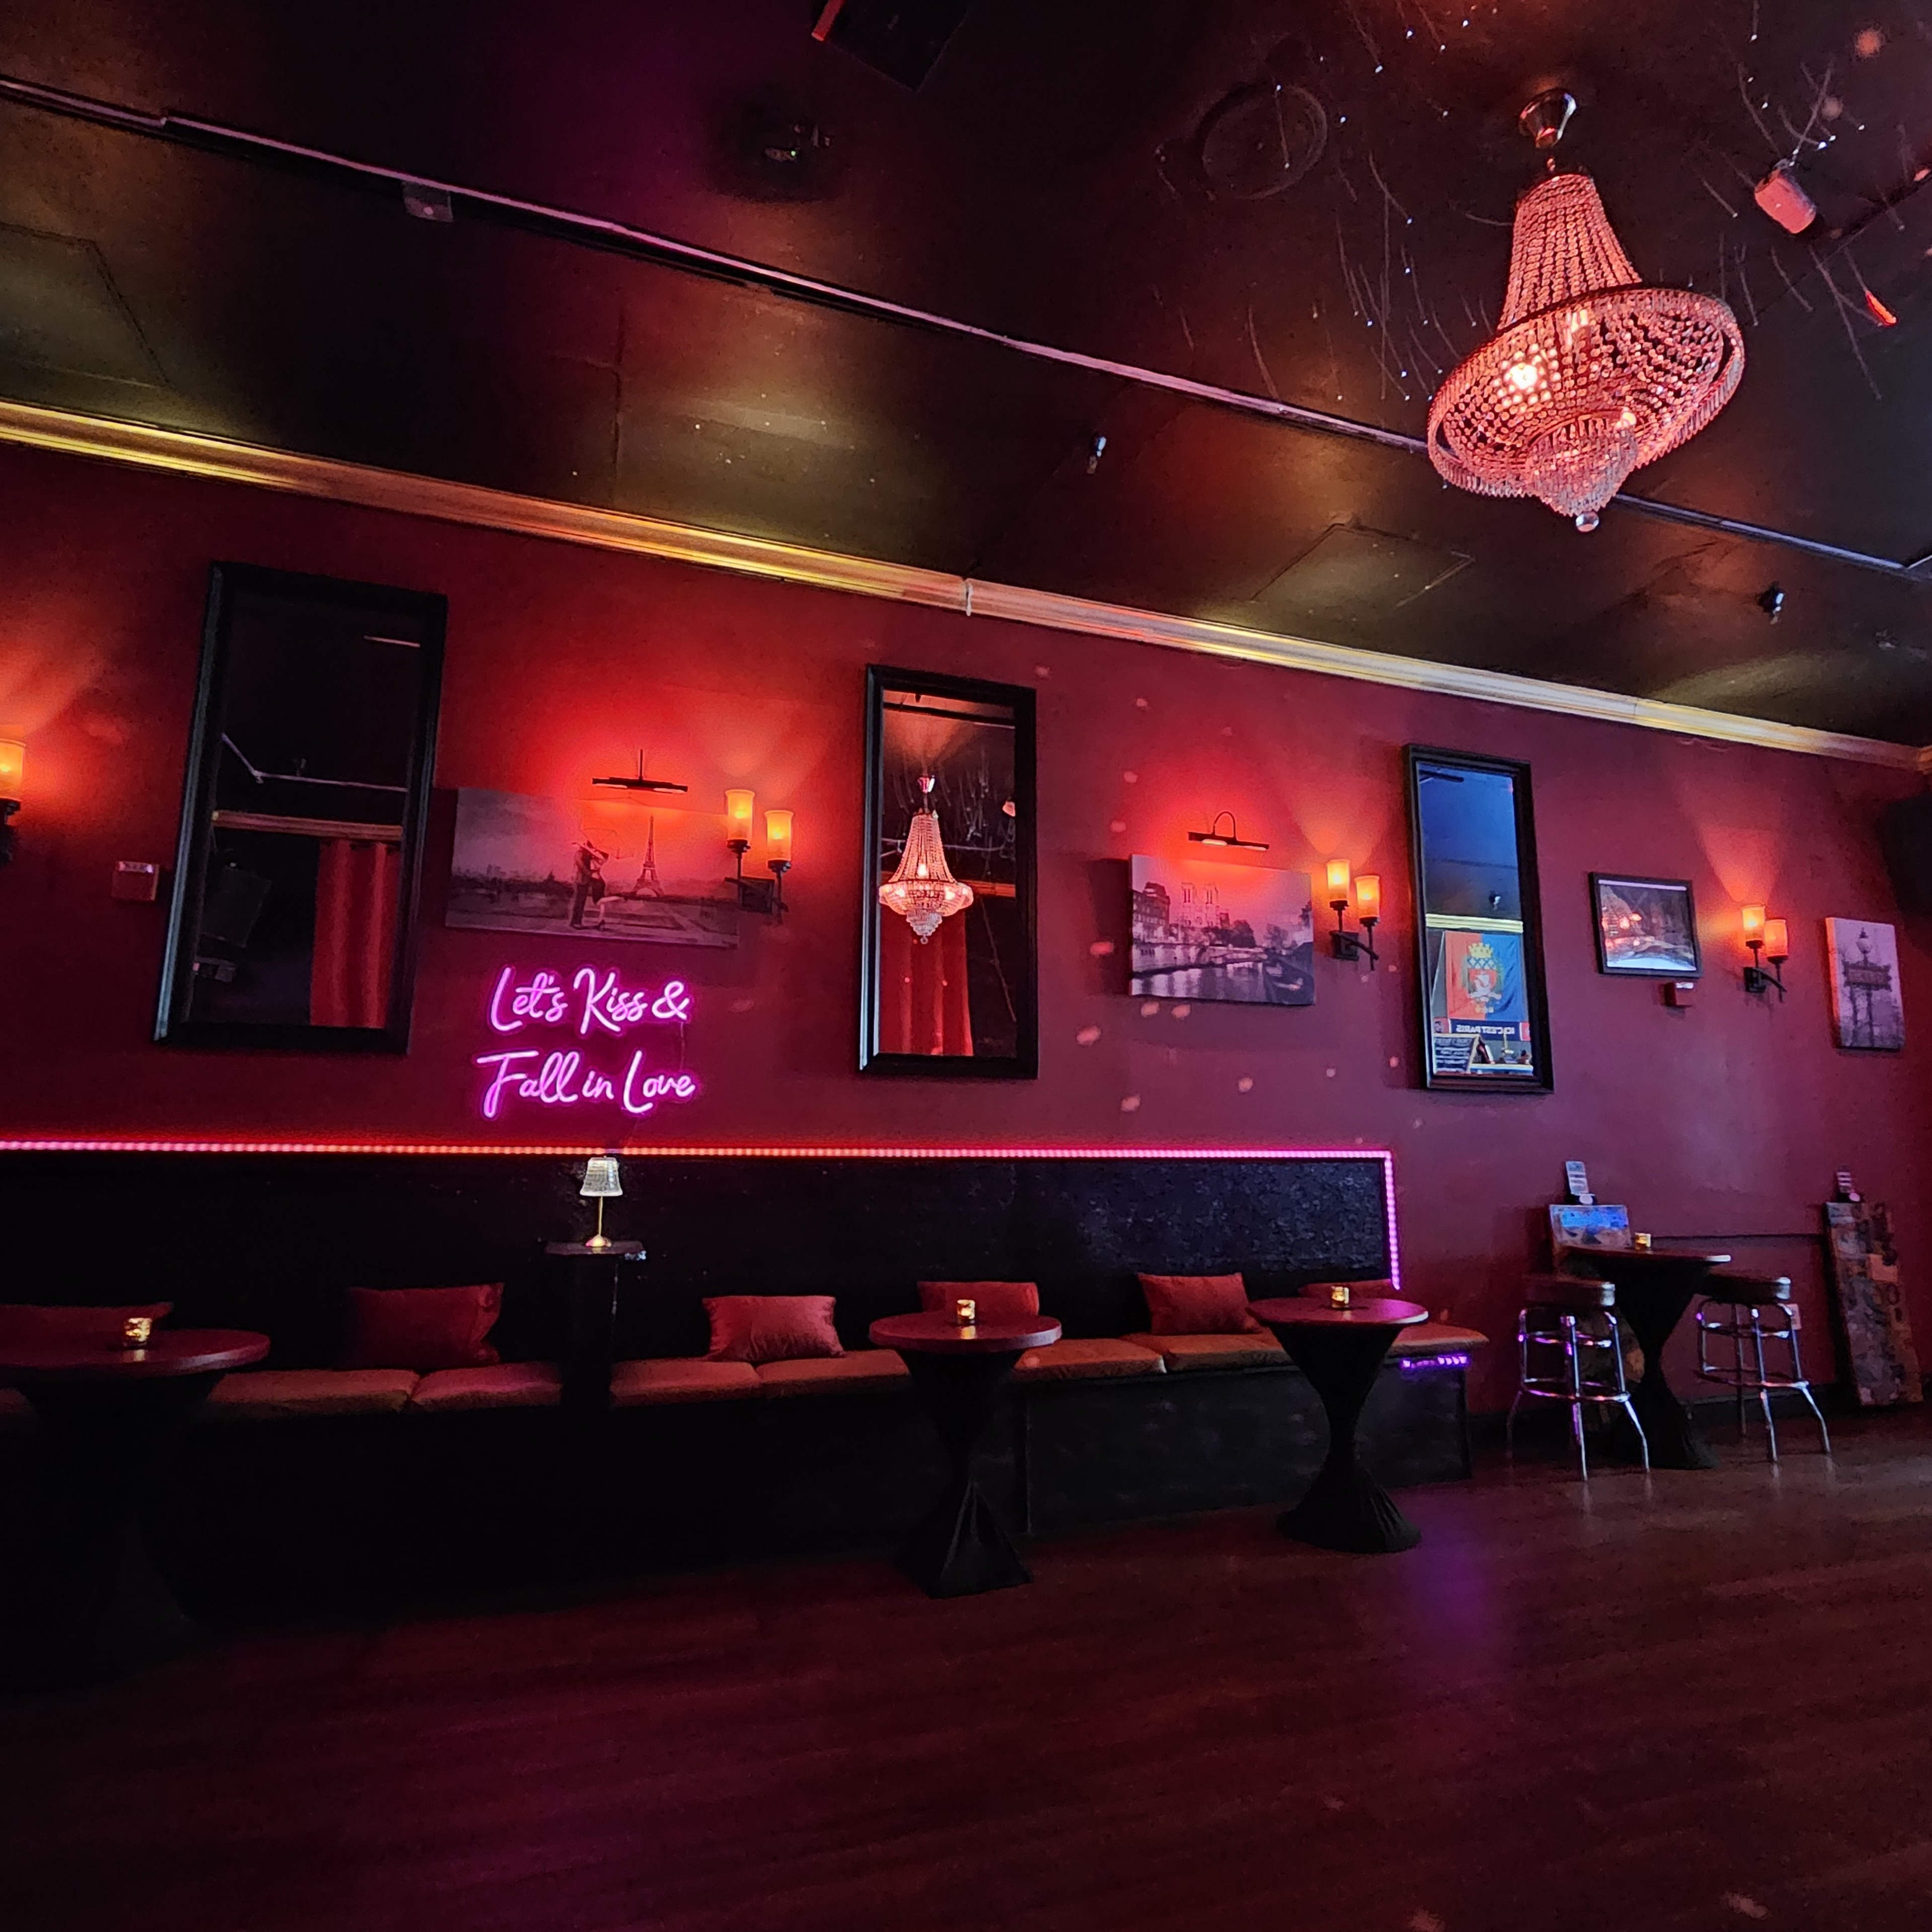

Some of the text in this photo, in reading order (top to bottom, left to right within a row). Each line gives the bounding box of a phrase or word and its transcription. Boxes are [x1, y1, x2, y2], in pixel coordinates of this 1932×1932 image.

[490, 967, 690, 1034] Let's Kiss &
[476, 1049, 696, 1118] Fall in Love
